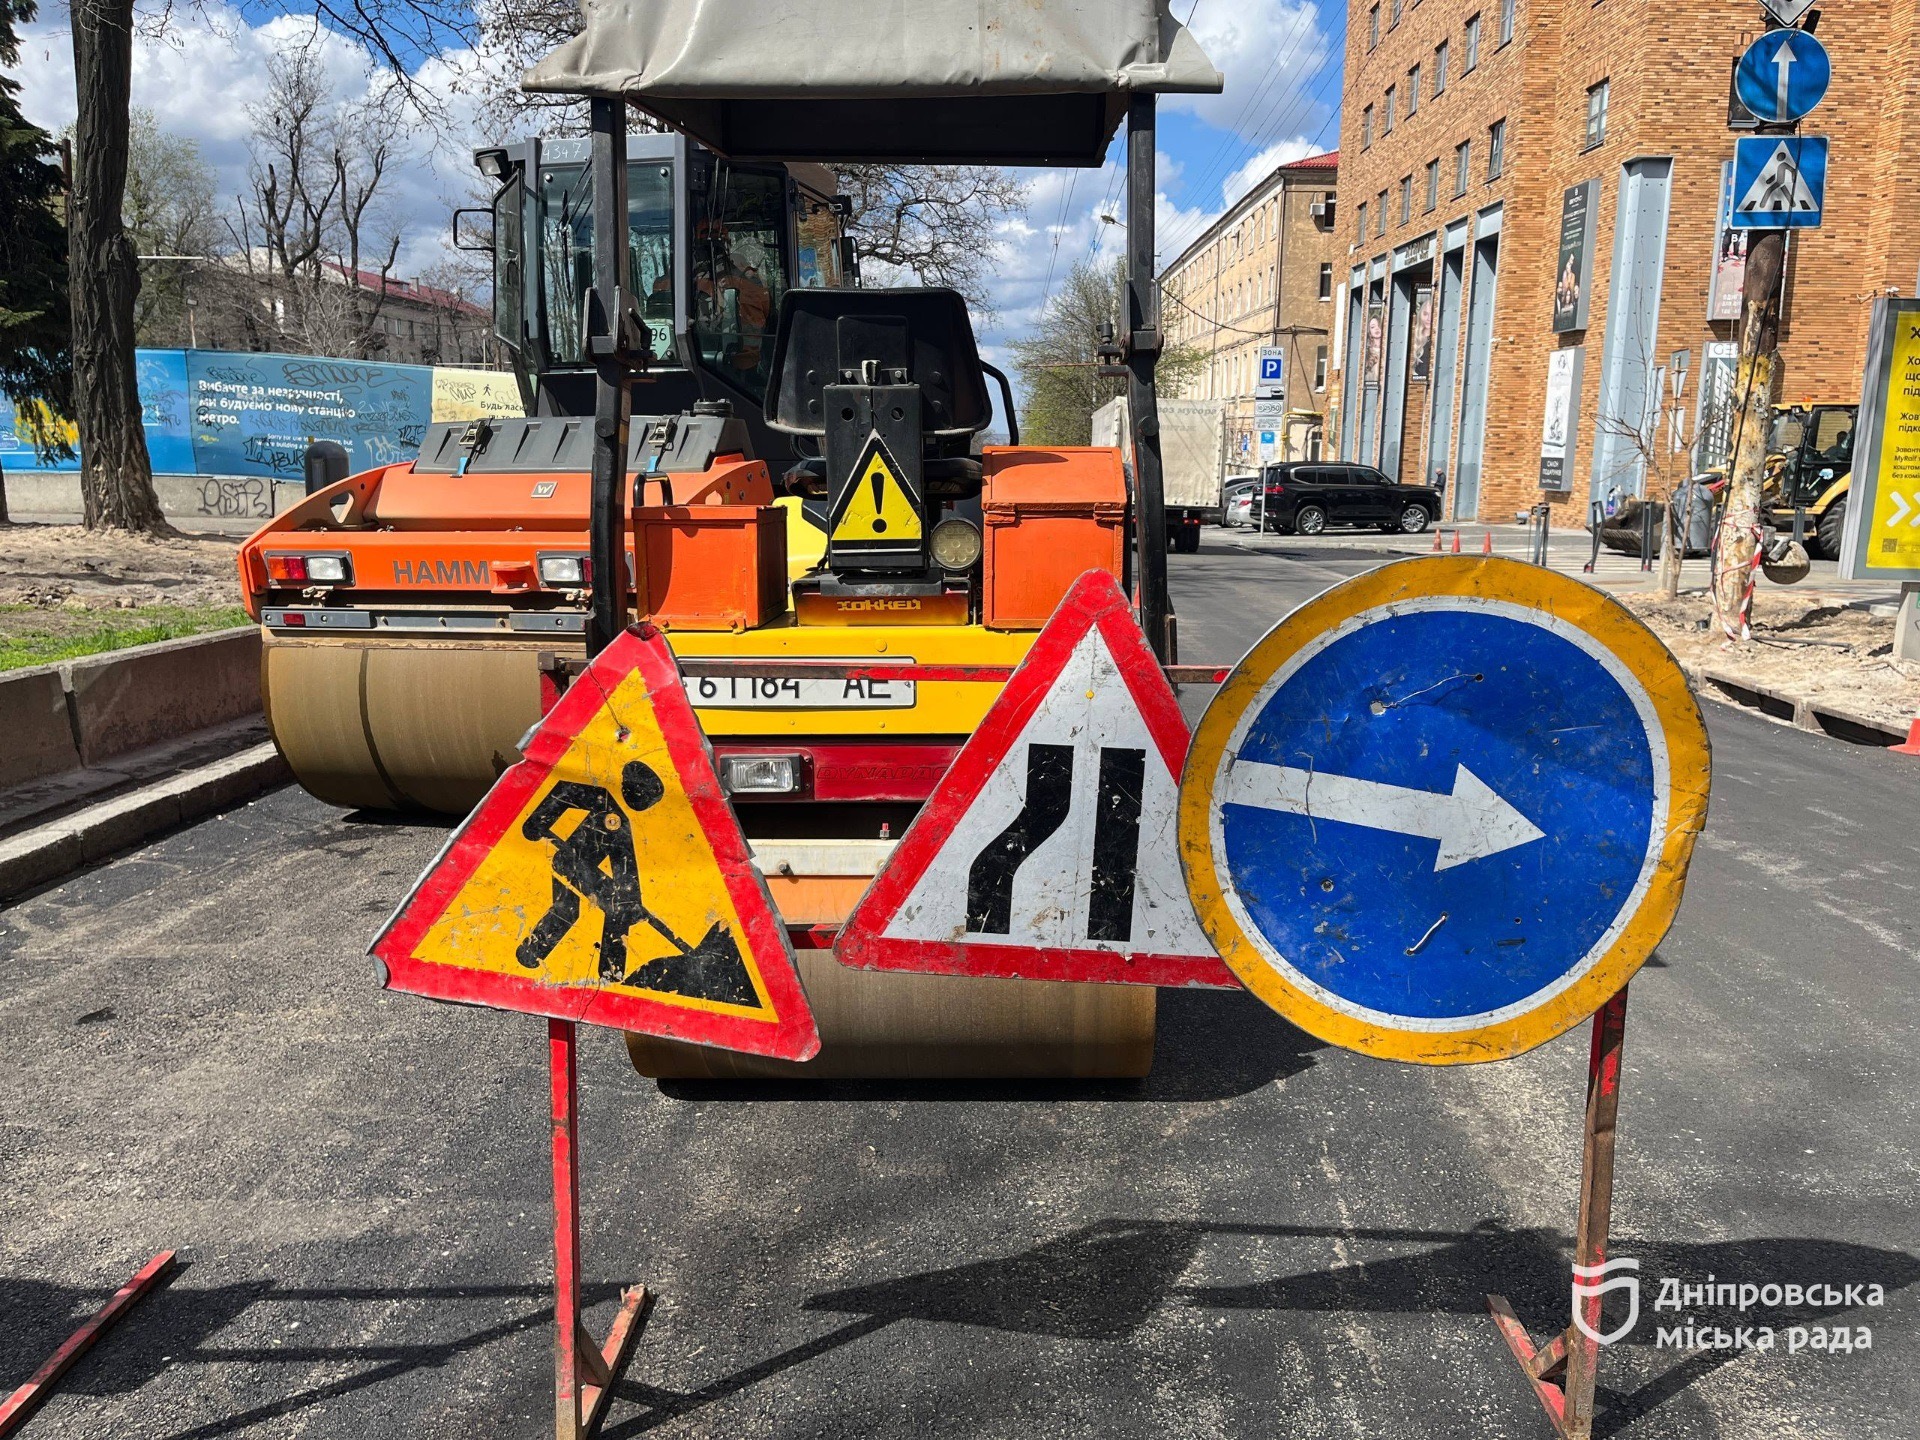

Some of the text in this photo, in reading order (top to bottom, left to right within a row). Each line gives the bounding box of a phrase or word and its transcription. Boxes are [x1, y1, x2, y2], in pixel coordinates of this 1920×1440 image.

[542, 142, 582, 161] 4347
[198, 379, 344, 405] Вибачте за незручності,
[198, 397, 217, 407] ми
[219, 397, 273, 412] будуємо
[275, 403, 305, 415] нову
[307, 404, 356, 419] станцію
[480, 401, 526, 412] Будь ласк
[199, 412, 240, 426] метро.
[267, 433, 282, 441] Sorry
[343, 438, 353, 446] but
[276, 441, 298, 450] building
[393, 560, 490, 585] HAMM
